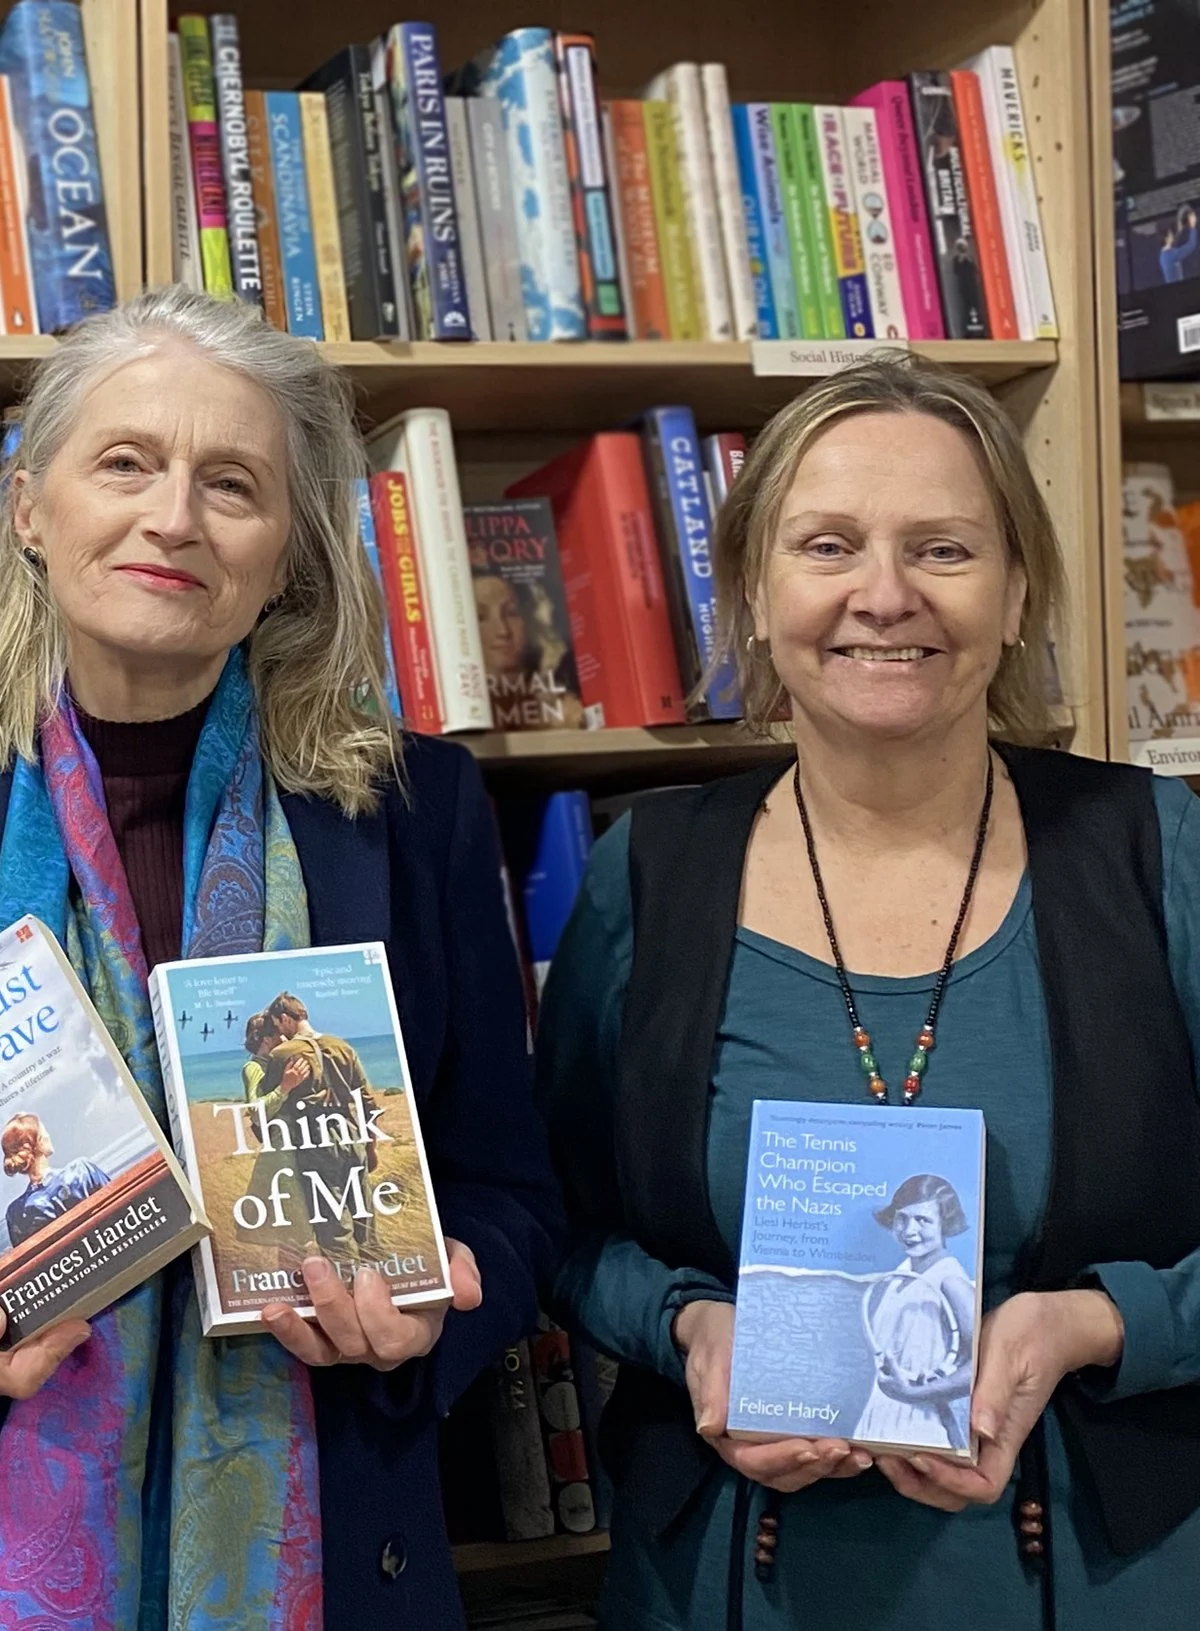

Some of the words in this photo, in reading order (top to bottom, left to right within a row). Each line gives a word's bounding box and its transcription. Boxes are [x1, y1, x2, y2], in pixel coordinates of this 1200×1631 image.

[410, 32, 441, 114] PARIS
[218, 45, 249, 181] CHERNOBYL
[420, 118, 446, 152] IN
[754, 108, 770, 151] Wise
[999, 66, 1026, 163] MAVERICKS
[168, 131, 187, 191] BENGAL
[821, 119, 843, 174] RACE
[852, 135, 869, 185] WORLD
[861, 121, 880, 184] MATERIAL
[44, 105, 104, 282] OCEAN
[267, 111, 305, 258] SCANDINAVIA
[425, 154, 456, 243] RUINS
[761, 154, 783, 225] Animals
[937, 168, 956, 215] BRITAIN
[949, 146, 971, 236] MULTICULTURAL
[173, 194, 192, 261] GAZETTE
[233, 181, 262, 292] ROULETTE
[832, 189, 857, 270] FUTURE
[869, 252, 889, 318] CONWAY
[881, 253, 893, 271] ED
[790, 350, 827, 363] Social
[829, 350, 864, 364] Histo
[385, 478, 409, 536] JOBS
[669, 435, 713, 580] CATLAND
[397, 554, 421, 624] GIRLS
[497, 699, 565, 726] MEN
[1147, 748, 1200, 765] Enviro
[4, 1061, 38, 1086] country
[35, 1055, 46, 1066] at
[213, 1087, 394, 1156] Think
[762, 1131, 796, 1150] The
[802, 1133, 857, 1152] Tennis
[758, 1174, 807, 1192] Who
[812, 1177, 887, 1201] Escaped
[759, 1152, 856, 1176] Champion
[232, 1167, 293, 1230] of
[303, 1165, 403, 1225] Me
[756, 1196, 786, 1212] the
[792, 1198, 842, 1216] Nazis
[0, 1247, 85, 1314] Frances
[81, 1194, 163, 1260] Liardet
[752, 1229, 797, 1245] Journey,
[799, 1231, 829, 1245] from
[752, 1244, 792, 1258] Vienna
[793, 1246, 807, 1258] to
[12, 1310, 32, 1324] THE
[32, 1256, 111, 1312] INTERNATIONAL
[111, 1214, 169, 1259] BESTSELLER
[231, 1268, 303, 1293] Franc
[739, 1397, 785, 1417] Felice
[788, 1402, 840, 1424] Hardy
